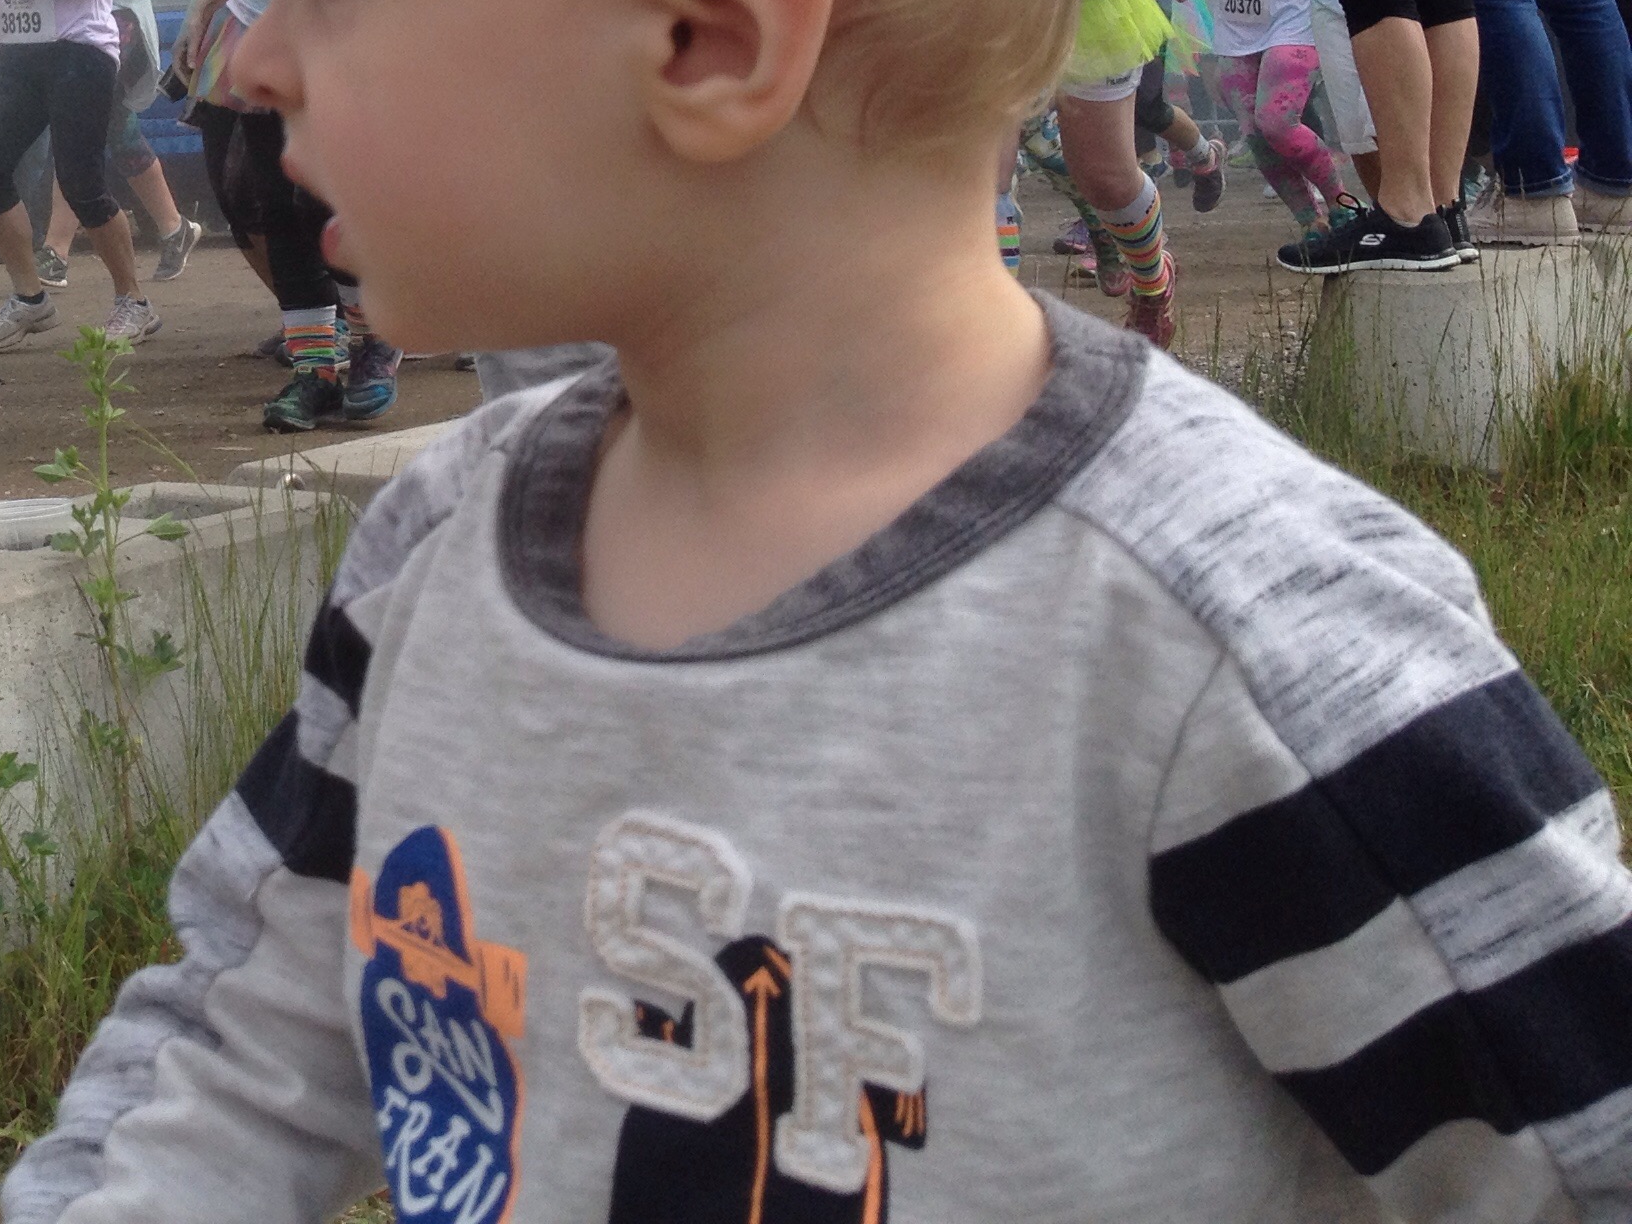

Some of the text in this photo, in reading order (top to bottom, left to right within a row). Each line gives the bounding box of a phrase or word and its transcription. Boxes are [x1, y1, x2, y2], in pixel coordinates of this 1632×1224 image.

[1, 11, 42, 34] 38139
[376, 977, 505, 1136] SAN
[577, 807, 982, 1195] SF
